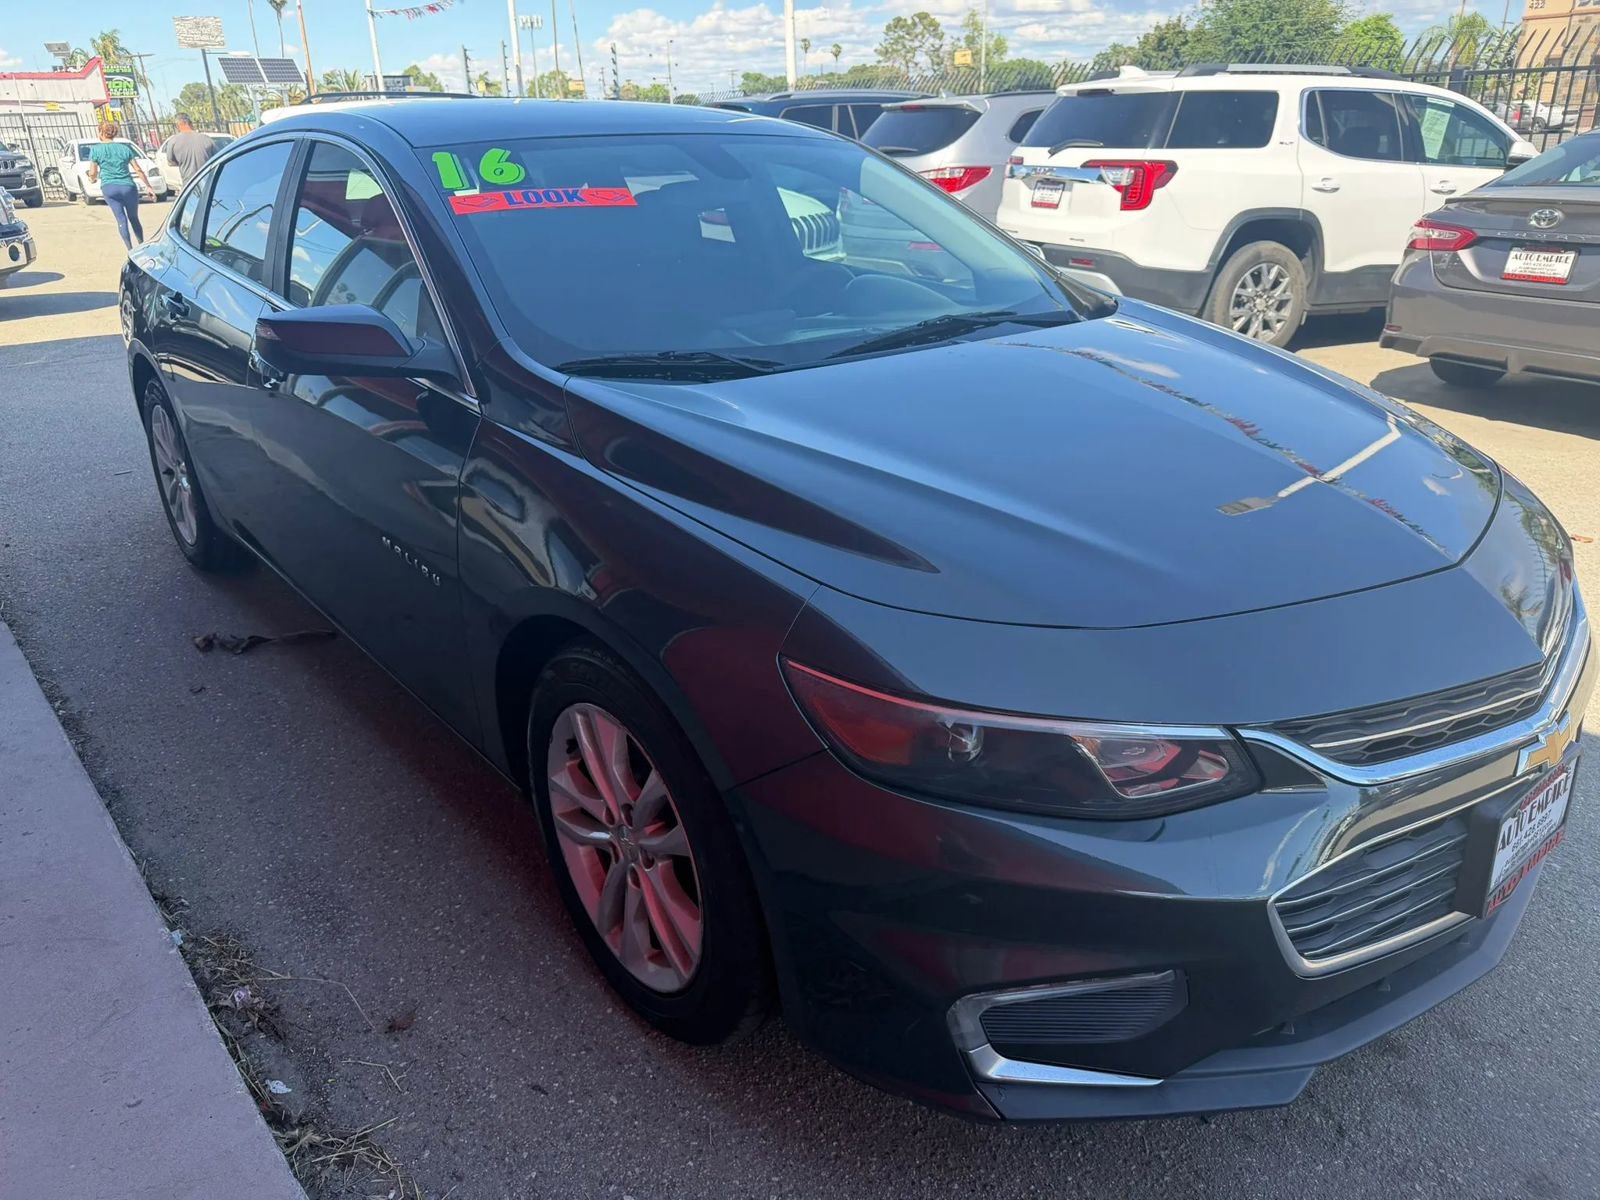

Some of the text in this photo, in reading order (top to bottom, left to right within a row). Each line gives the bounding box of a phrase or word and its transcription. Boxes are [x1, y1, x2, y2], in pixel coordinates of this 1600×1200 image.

[432, 148, 526, 190] 16
[502, 189, 587, 207] LOOK
[382, 536, 441, 586] MALIBU
[1498, 809, 1528, 852] AUTO
[1526, 772, 1572, 825] EMPIRE
